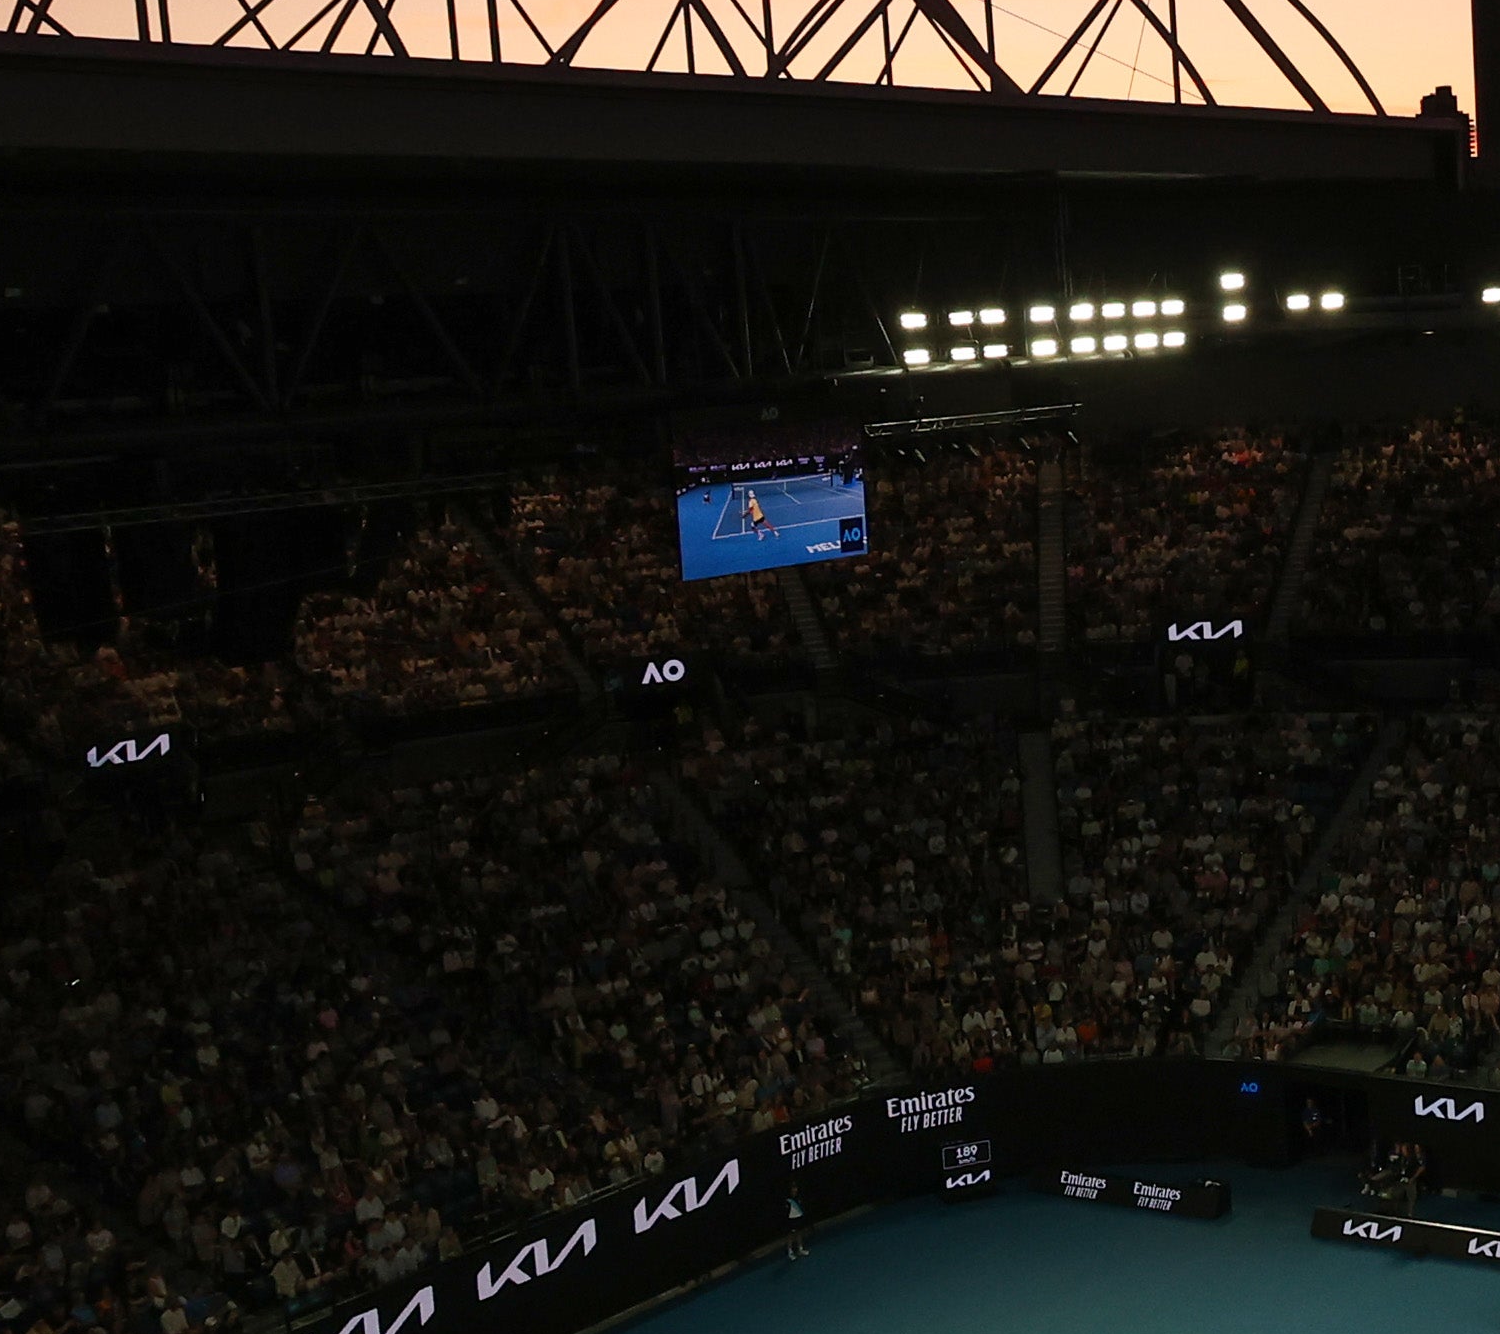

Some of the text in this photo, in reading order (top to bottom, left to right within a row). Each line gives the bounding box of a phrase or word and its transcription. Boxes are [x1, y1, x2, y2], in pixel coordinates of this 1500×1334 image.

[842, 527, 861, 543] AO
[1168, 620, 1242, 640] KIA
[642, 660, 684, 684] AO
[87, 734, 169, 766] KIA
[1240, 1082, 1259, 1093] AO
[886, 1086, 975, 1118] Emirates
[1415, 1096, 1484, 1122] KIA
[901, 1106, 963, 1133] FLY BETTER
[779, 1115, 853, 1156] Emirates
[791, 1136, 843, 1171] FLY BETTER
[955, 1145, 978, 1159] 189
[947, 1170, 990, 1188] KIA
[1060, 1170, 1107, 1190] Emirates
[1076, 1187, 1098, 1200] BETTER
[1133, 1181, 1182, 1201] Emirates
[1149, 1198, 1172, 1211] BETTER
[477, 1219, 596, 1300] KIA
[634, 1159, 739, 1233] KIA
[1343, 1220, 1401, 1241] KIA
